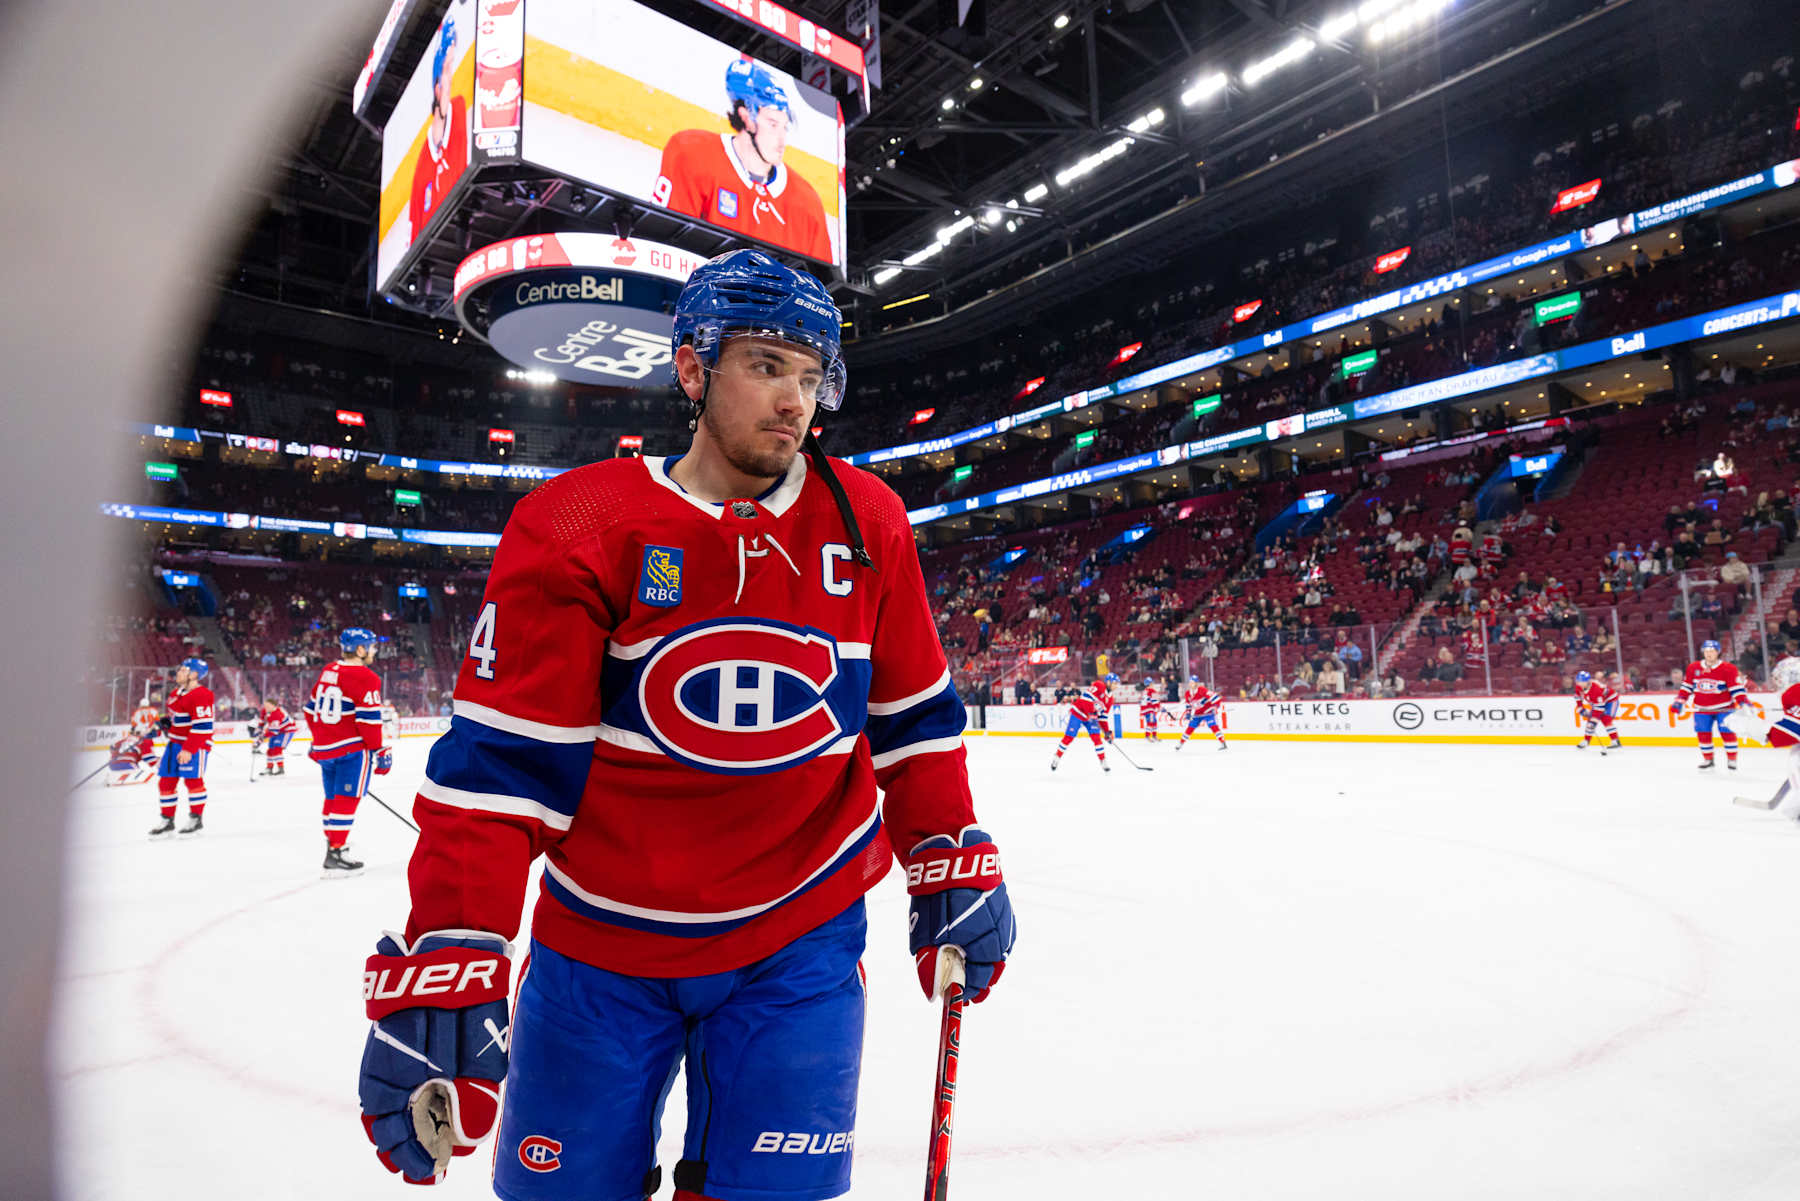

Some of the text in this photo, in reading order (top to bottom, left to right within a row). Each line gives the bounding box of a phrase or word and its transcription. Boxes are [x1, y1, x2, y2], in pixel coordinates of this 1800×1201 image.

[1637, 173, 1765, 221] THE CHAINSMOKERS
[651, 250, 672, 270] GO
[1703, 307, 1769, 336] CONCERTS
[534, 320, 617, 364] Centre
[1611, 332, 1646, 356] Bell
[821, 542, 854, 597] C
[646, 586, 679, 602] RBC
[195, 706, 212, 718] 54
[1267, 702, 1351, 716] THE KEG
[1433, 708, 1544, 721] CFMOTO
[1574, 702, 1660, 728] pza
[362, 958, 499, 1001] AUER
